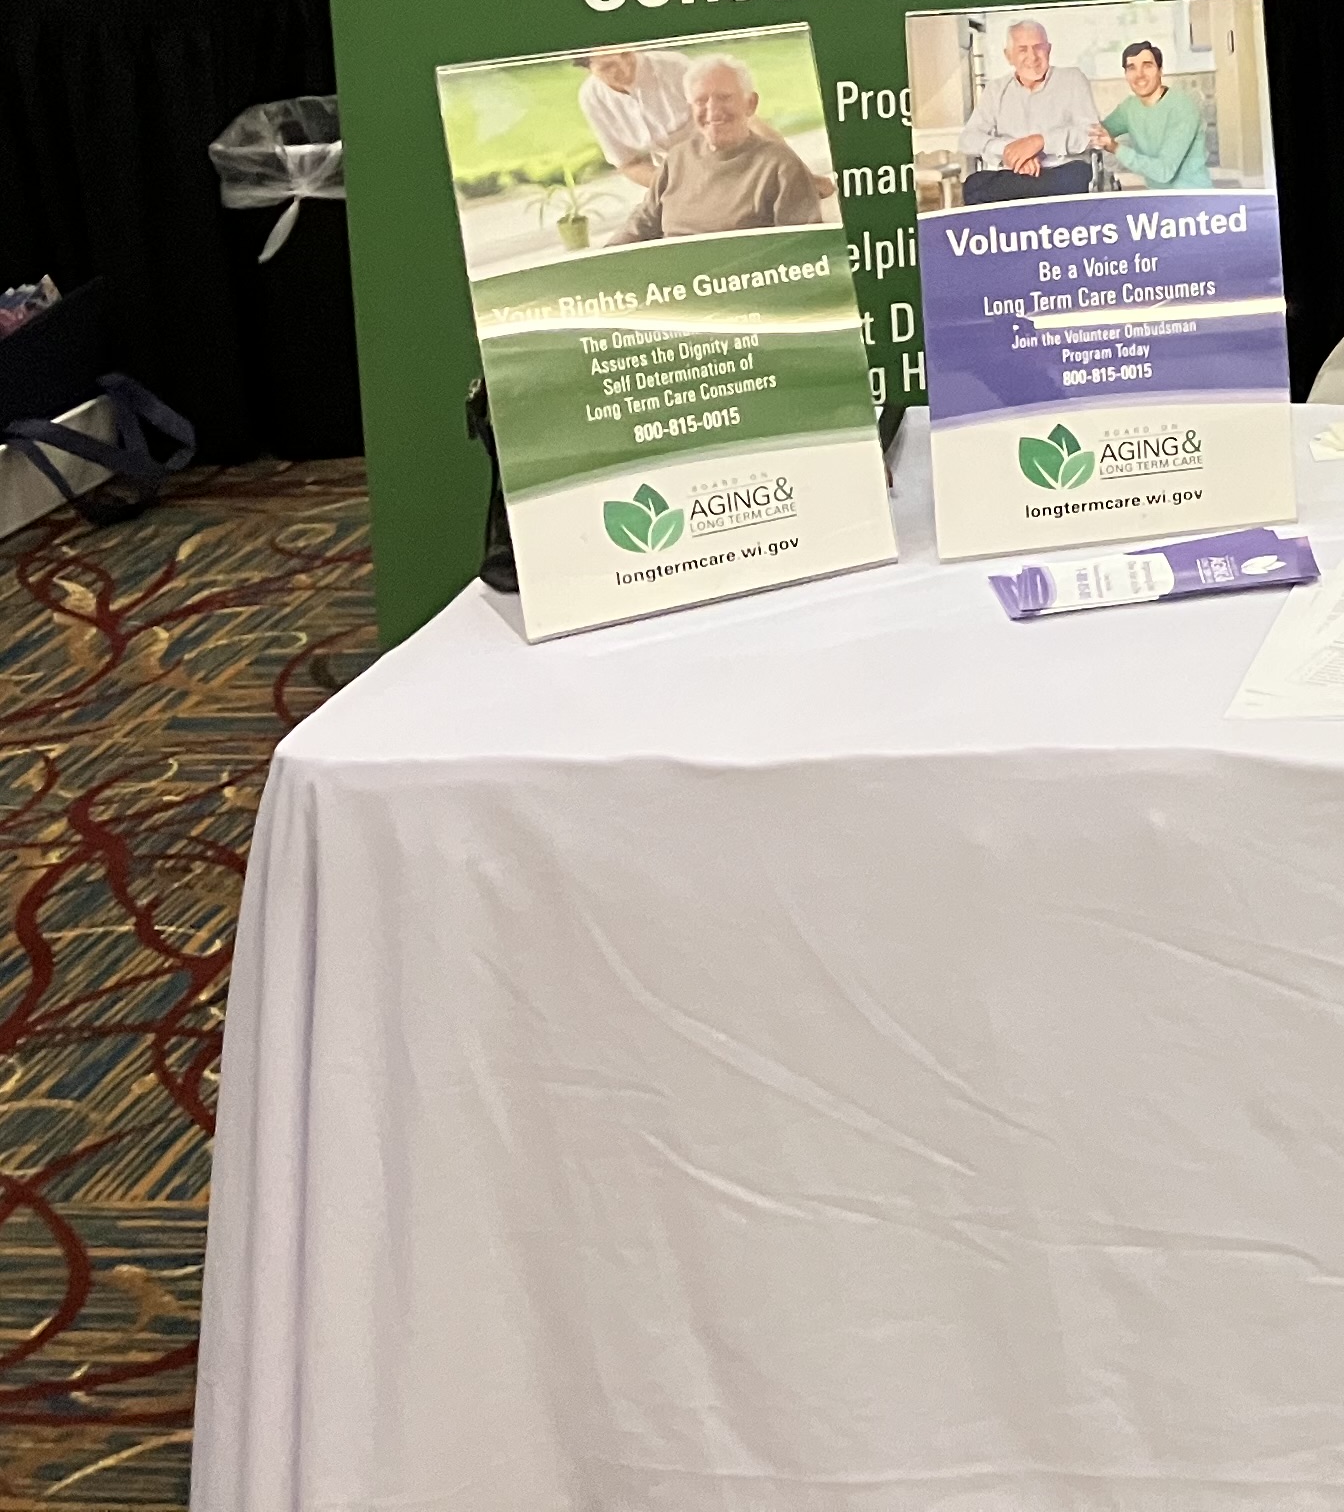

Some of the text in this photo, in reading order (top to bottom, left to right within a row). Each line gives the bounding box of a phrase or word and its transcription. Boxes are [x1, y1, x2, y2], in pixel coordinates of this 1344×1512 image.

[946, 204, 1248, 257] Volunteers Wanted
[646, 281, 687, 306] Are
[692, 255, 830, 298] Guaranteed
[1039, 253, 1158, 282] Be a Voice for
[983, 280, 1216, 317] Long Term Care Consumers
[580, 335, 608, 355] The
[1011, 320, 1197, 350] Join the Volunteer Ombudsman
[590, 333, 759, 376] Assures the Dignity and
[1062, 343, 1150, 364] Program Today
[602, 353, 753, 396] Self Determination of
[1062, 363, 1153, 386] 800-815-0015
[586, 374, 777, 422] Long Term Care Consumers
[633, 407, 741, 443] 800-815-0015
[1100, 429, 1202, 464] AGING &
[1100, 454, 1203, 475] LONG TERM CARE
[690, 476, 794, 521] AGING &
[1025, 489, 1203, 519] longtermcare.wi.gov
[689, 501, 797, 534] LONG TERM CARE
[615, 537, 799, 586] longtermcare.wi.gov
